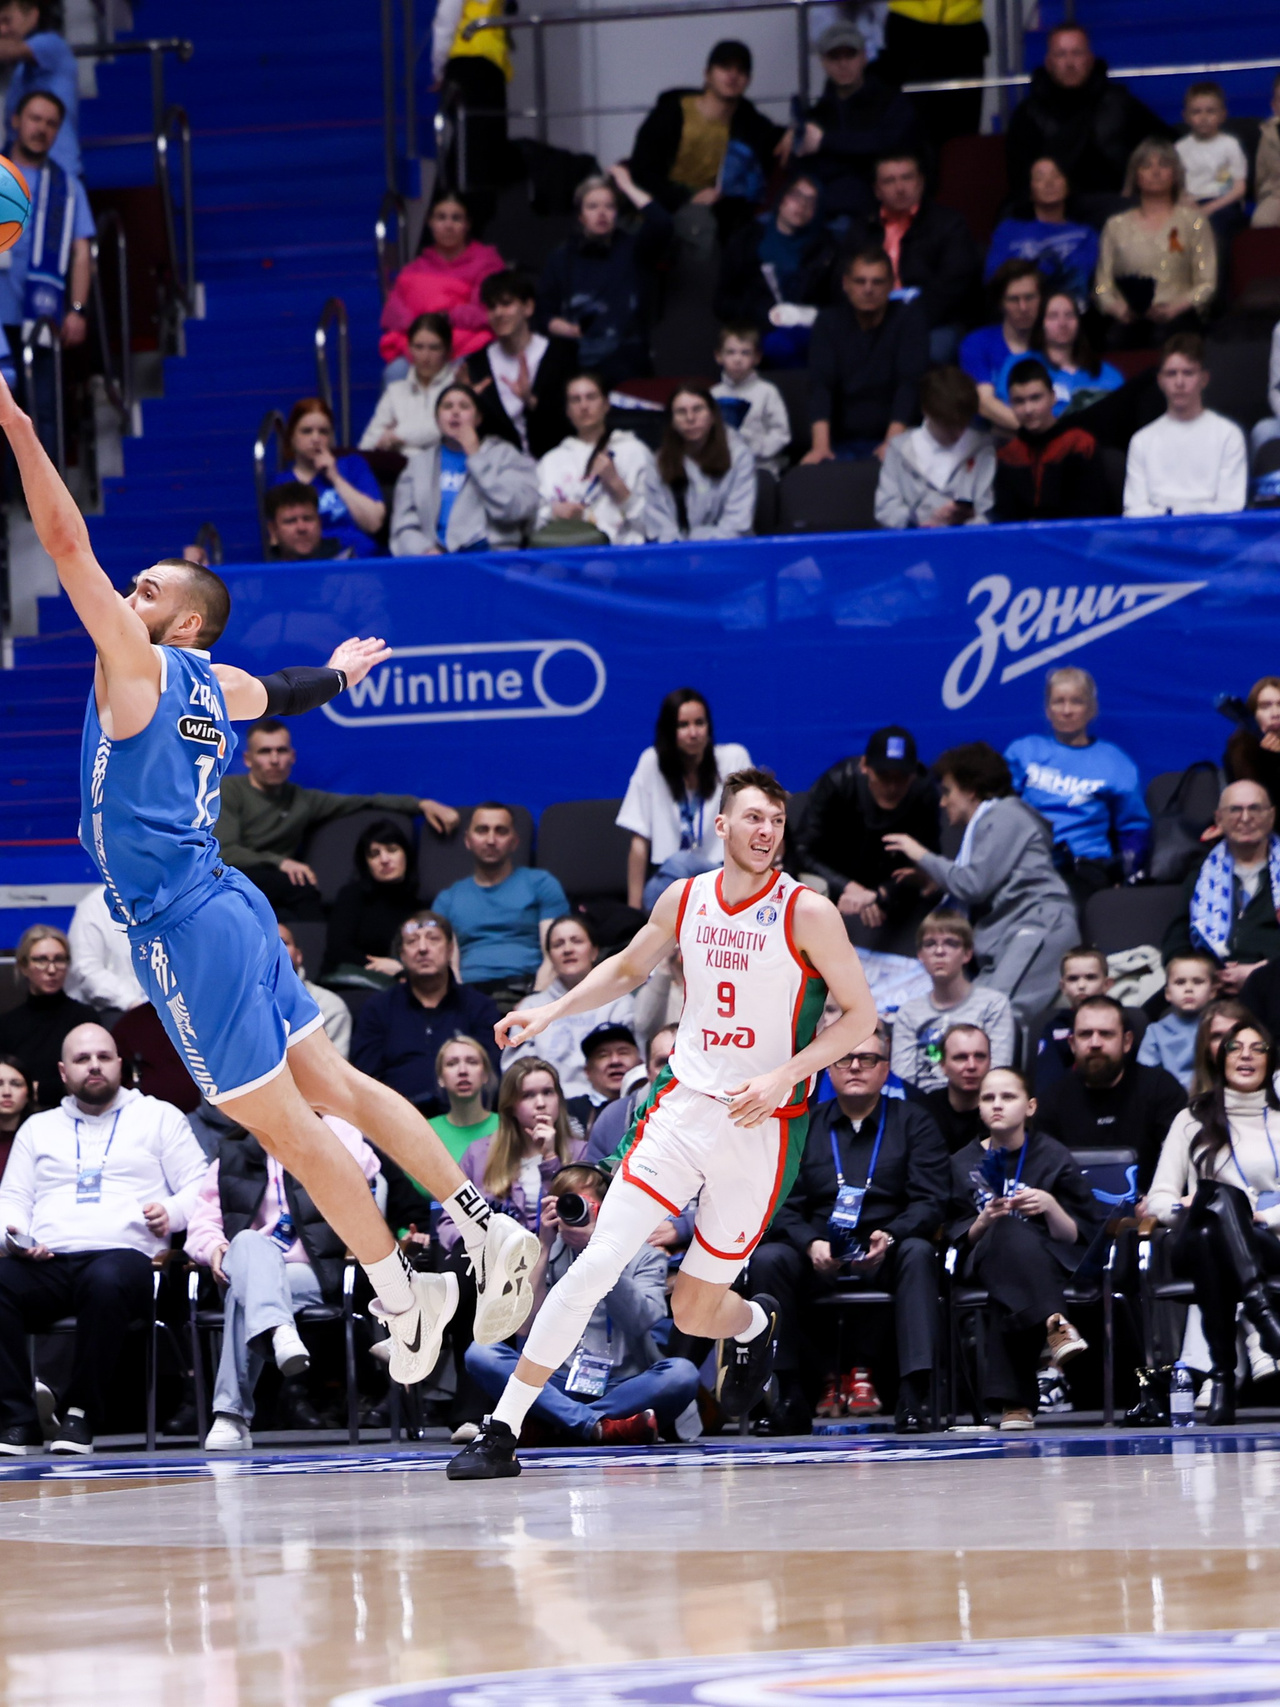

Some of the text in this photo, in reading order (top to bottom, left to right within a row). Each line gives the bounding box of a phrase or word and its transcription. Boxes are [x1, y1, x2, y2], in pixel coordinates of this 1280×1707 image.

[348, 663, 523, 708] Winline
[696, 926, 767, 952] LOKOMOTIV
[706, 949, 749, 972] KUBAN
[717, 982, 736, 1018] 9
